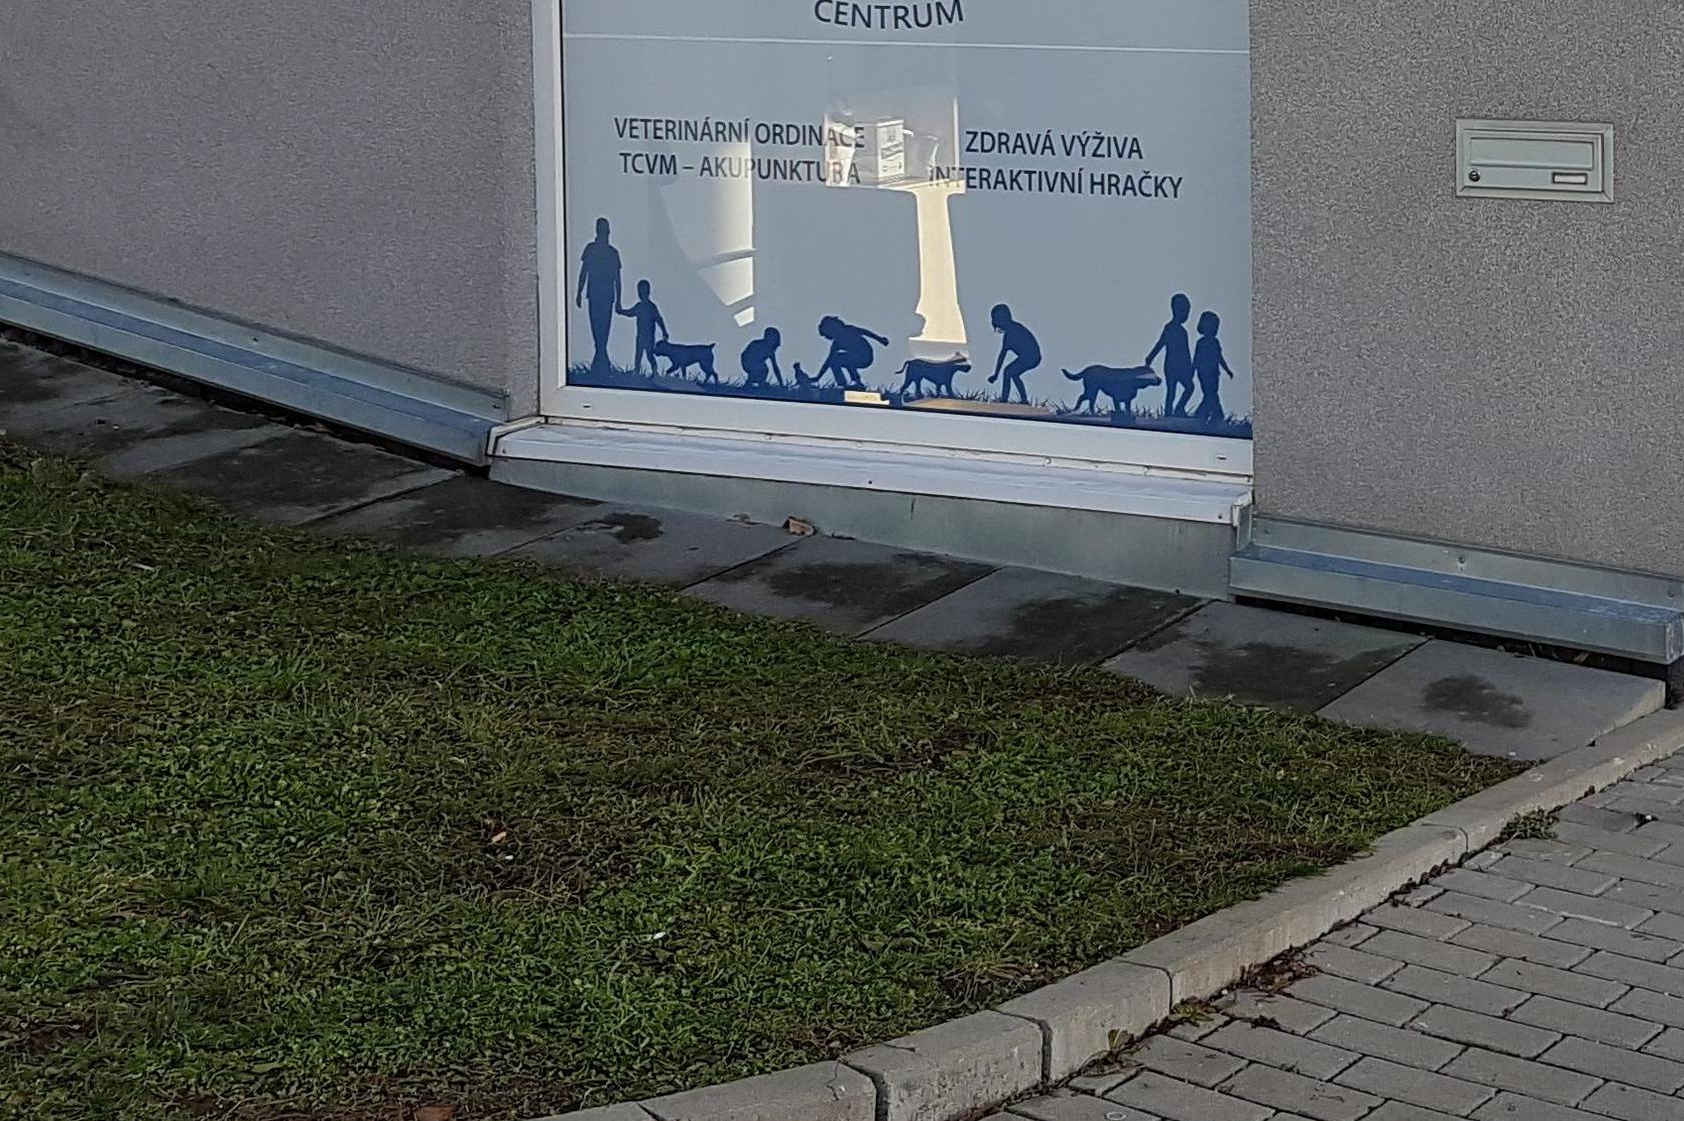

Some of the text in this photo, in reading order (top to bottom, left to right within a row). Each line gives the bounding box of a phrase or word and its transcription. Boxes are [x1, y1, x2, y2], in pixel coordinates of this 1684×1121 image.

[614, 116, 865, 149] VETERINÁRNÍ ORDINACE
[965, 130, 1144, 160] ZDRAVÁ VÝŽIVA
[619, 152, 678, 175] TCVM
[700, 156, 861, 184] AKUPUNKTURA
[930, 166, 1184, 199] INTERAKTIVNÍ HRAČKY
